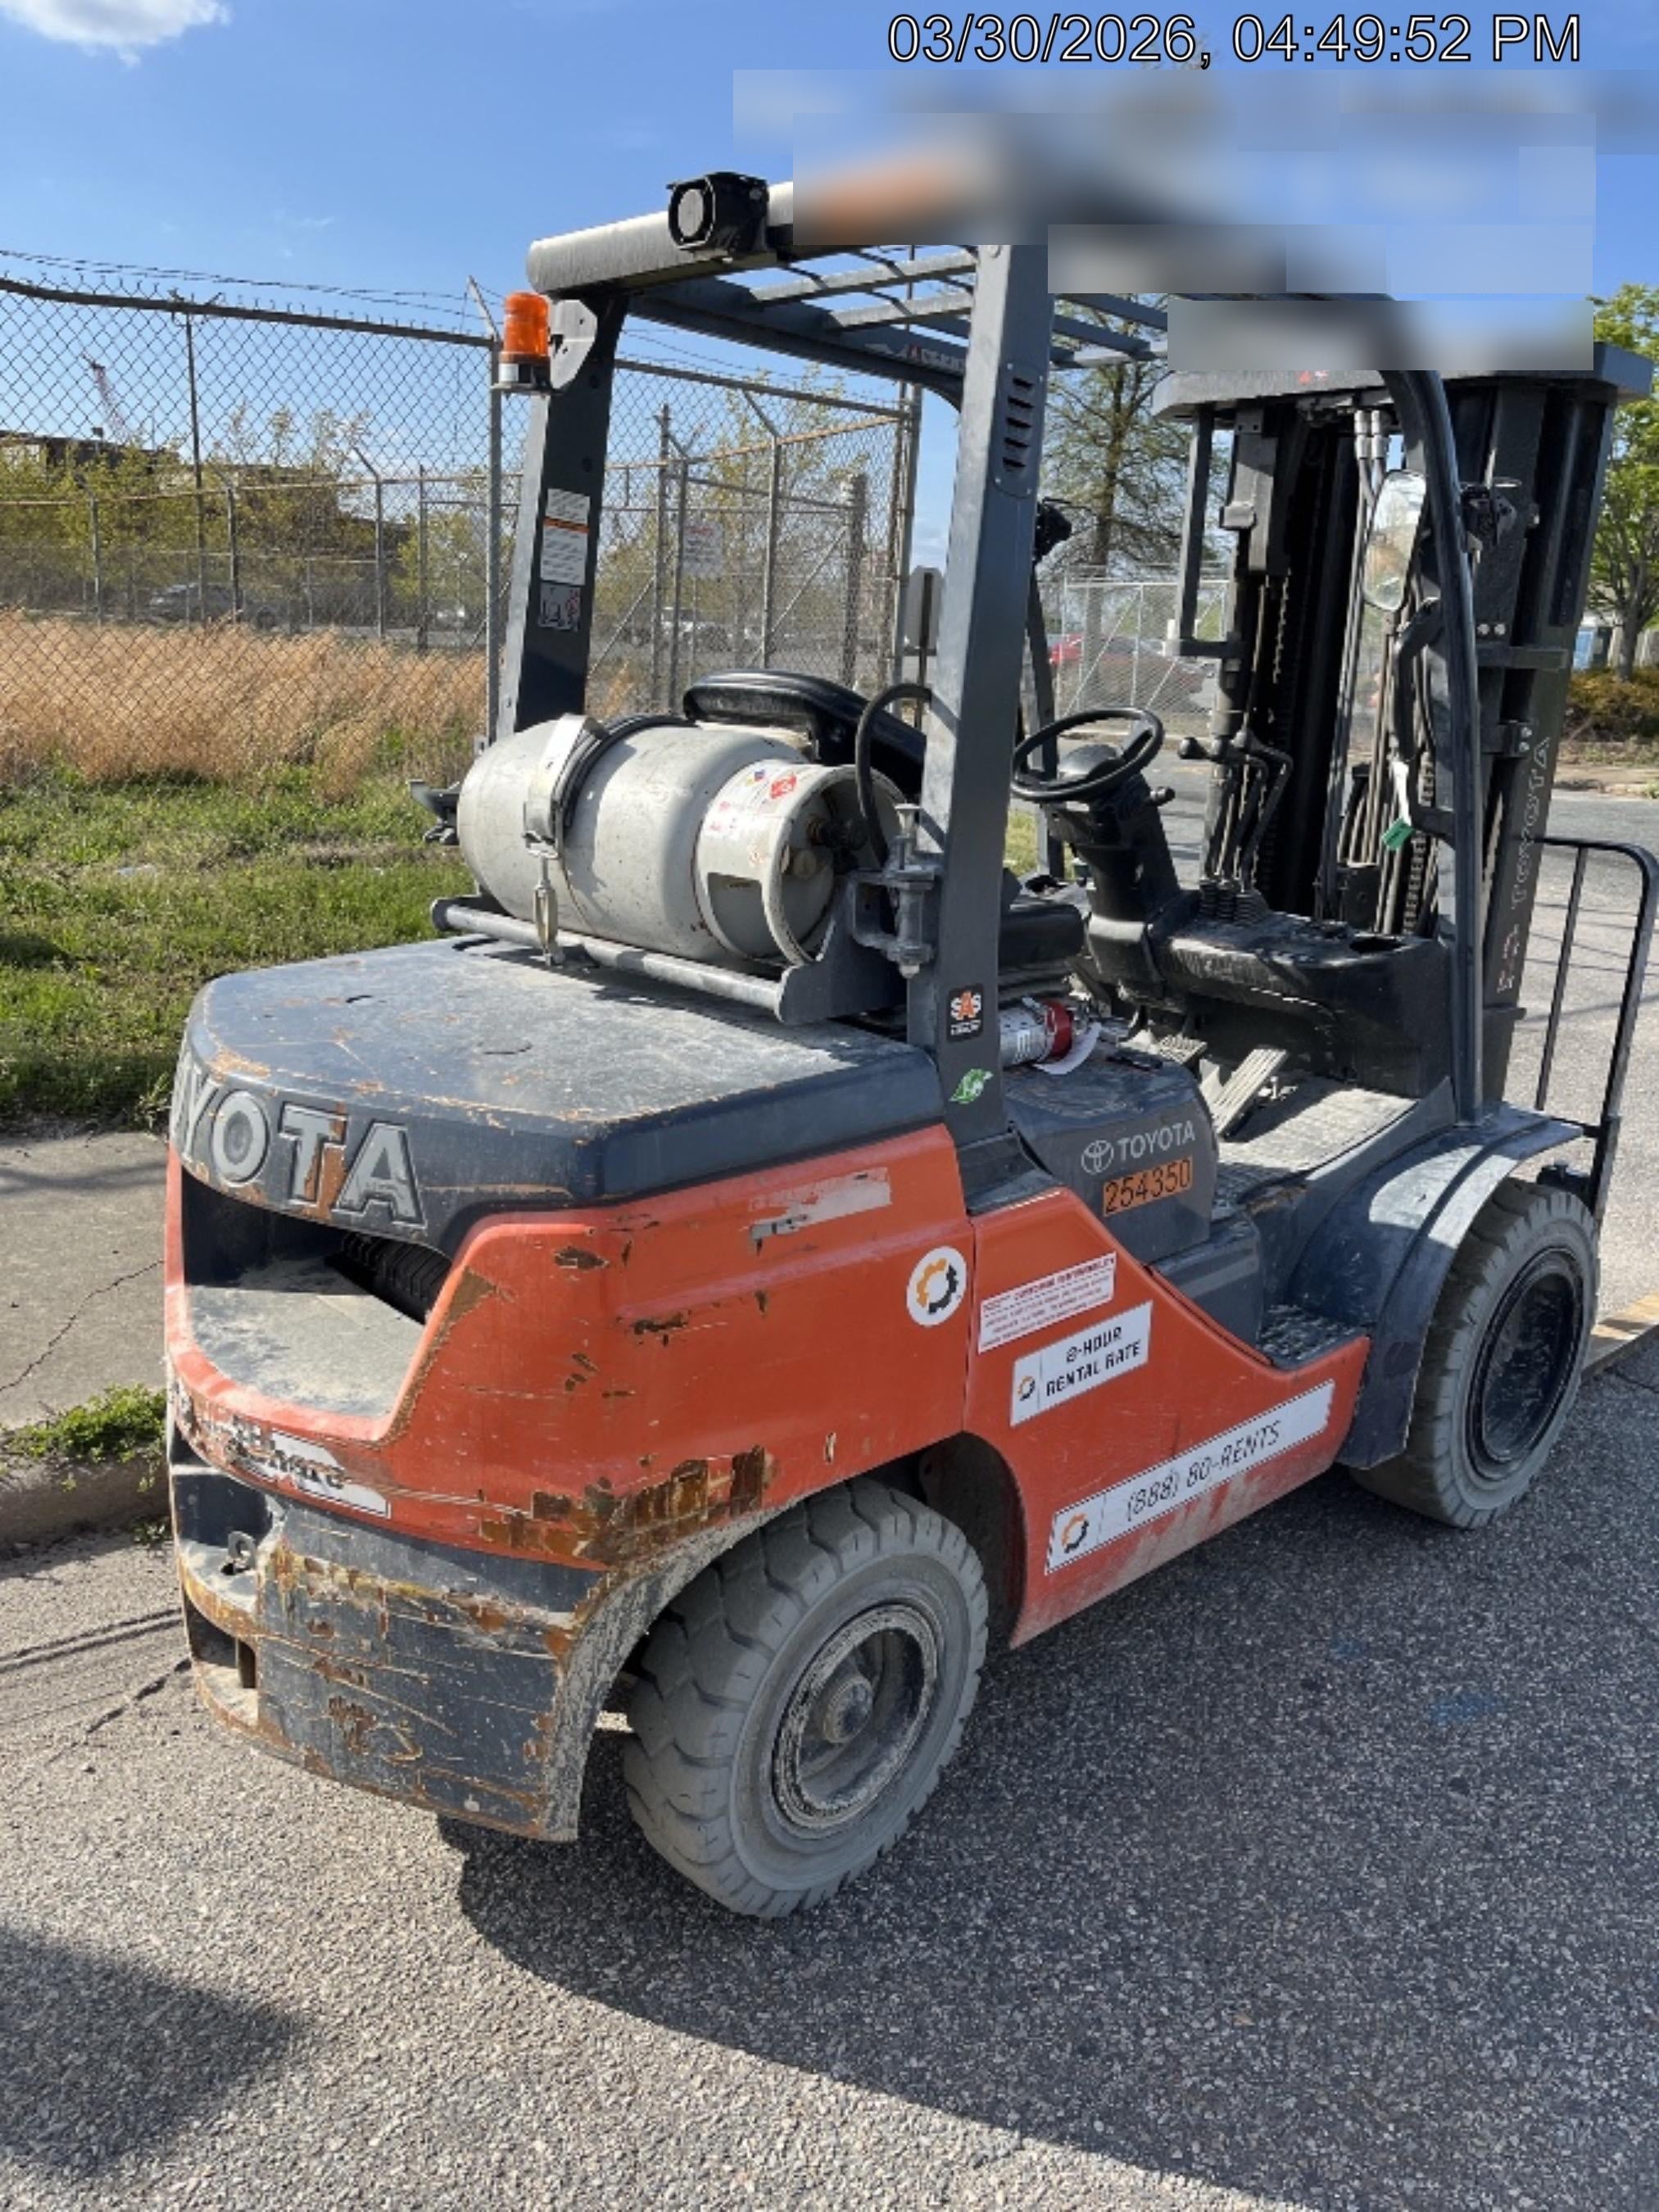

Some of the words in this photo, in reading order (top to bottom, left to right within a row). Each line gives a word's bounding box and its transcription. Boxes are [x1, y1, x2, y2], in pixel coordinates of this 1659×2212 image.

[1510, 736, 1551, 910] TOYOTA
[1117, 1120, 1195, 1161] TOYOTA
[1105, 1158, 1190, 1213] 254350
[1046, 1361, 1101, 1397] RENTAL
[1105, 1339, 1140, 1370] RATE
[1126, 1467, 1181, 1521] (888)
[1186, 1420, 1281, 1488] 80-RENTS
